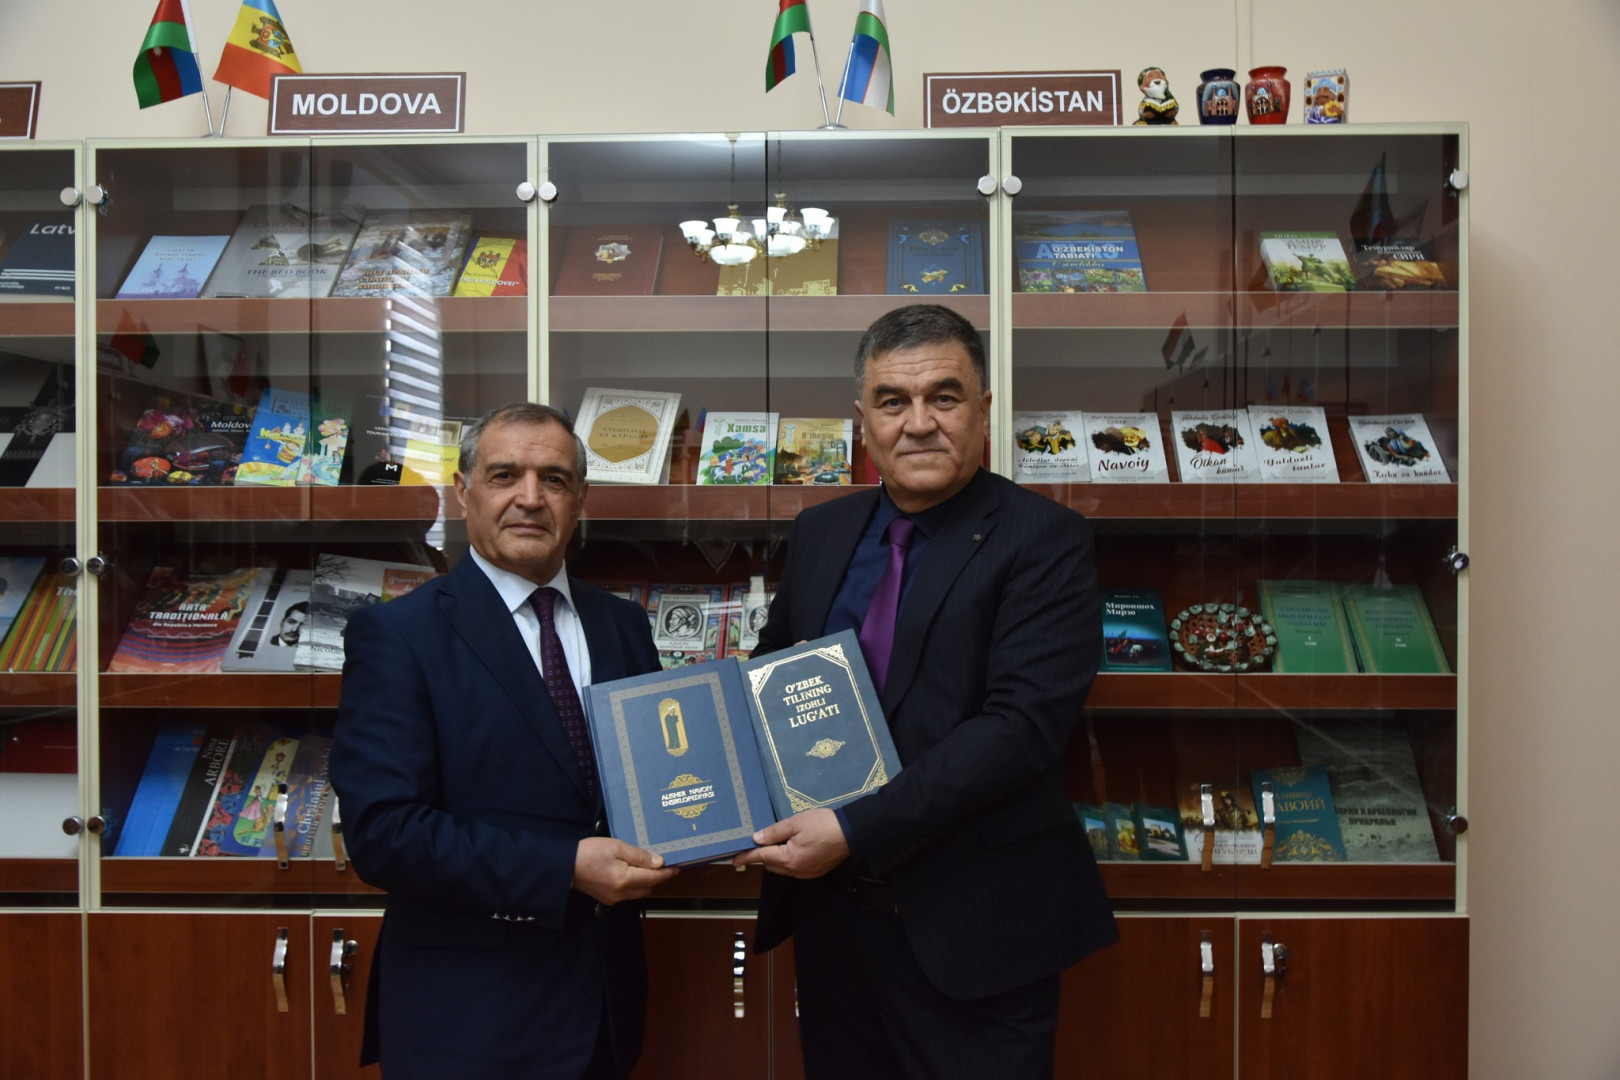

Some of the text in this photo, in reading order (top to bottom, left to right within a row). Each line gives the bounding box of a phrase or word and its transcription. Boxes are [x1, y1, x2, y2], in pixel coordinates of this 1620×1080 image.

[291, 92, 442, 116] MOLDOVA
[941, 86, 1104, 114] ÖZBƏKİSTAN
[30, 223, 76, 236] Latv
[210, 421, 251, 429] Moldov
[727, 423, 767, 433] Xamsa
[385, 463, 398, 472] M
[1098, 457, 1150, 472] Navoiy
[178, 603, 208, 612] ARTA
[1106, 608, 1136, 617] Мирзо
[782, 684, 833, 706] TILINING
[796, 697, 827, 713] IZOHLI
[204, 739, 230, 787] ARBORE
[661, 785, 713, 801] ALISHER NAVOIY
[1275, 797, 1327, 812] АВОИЙ
